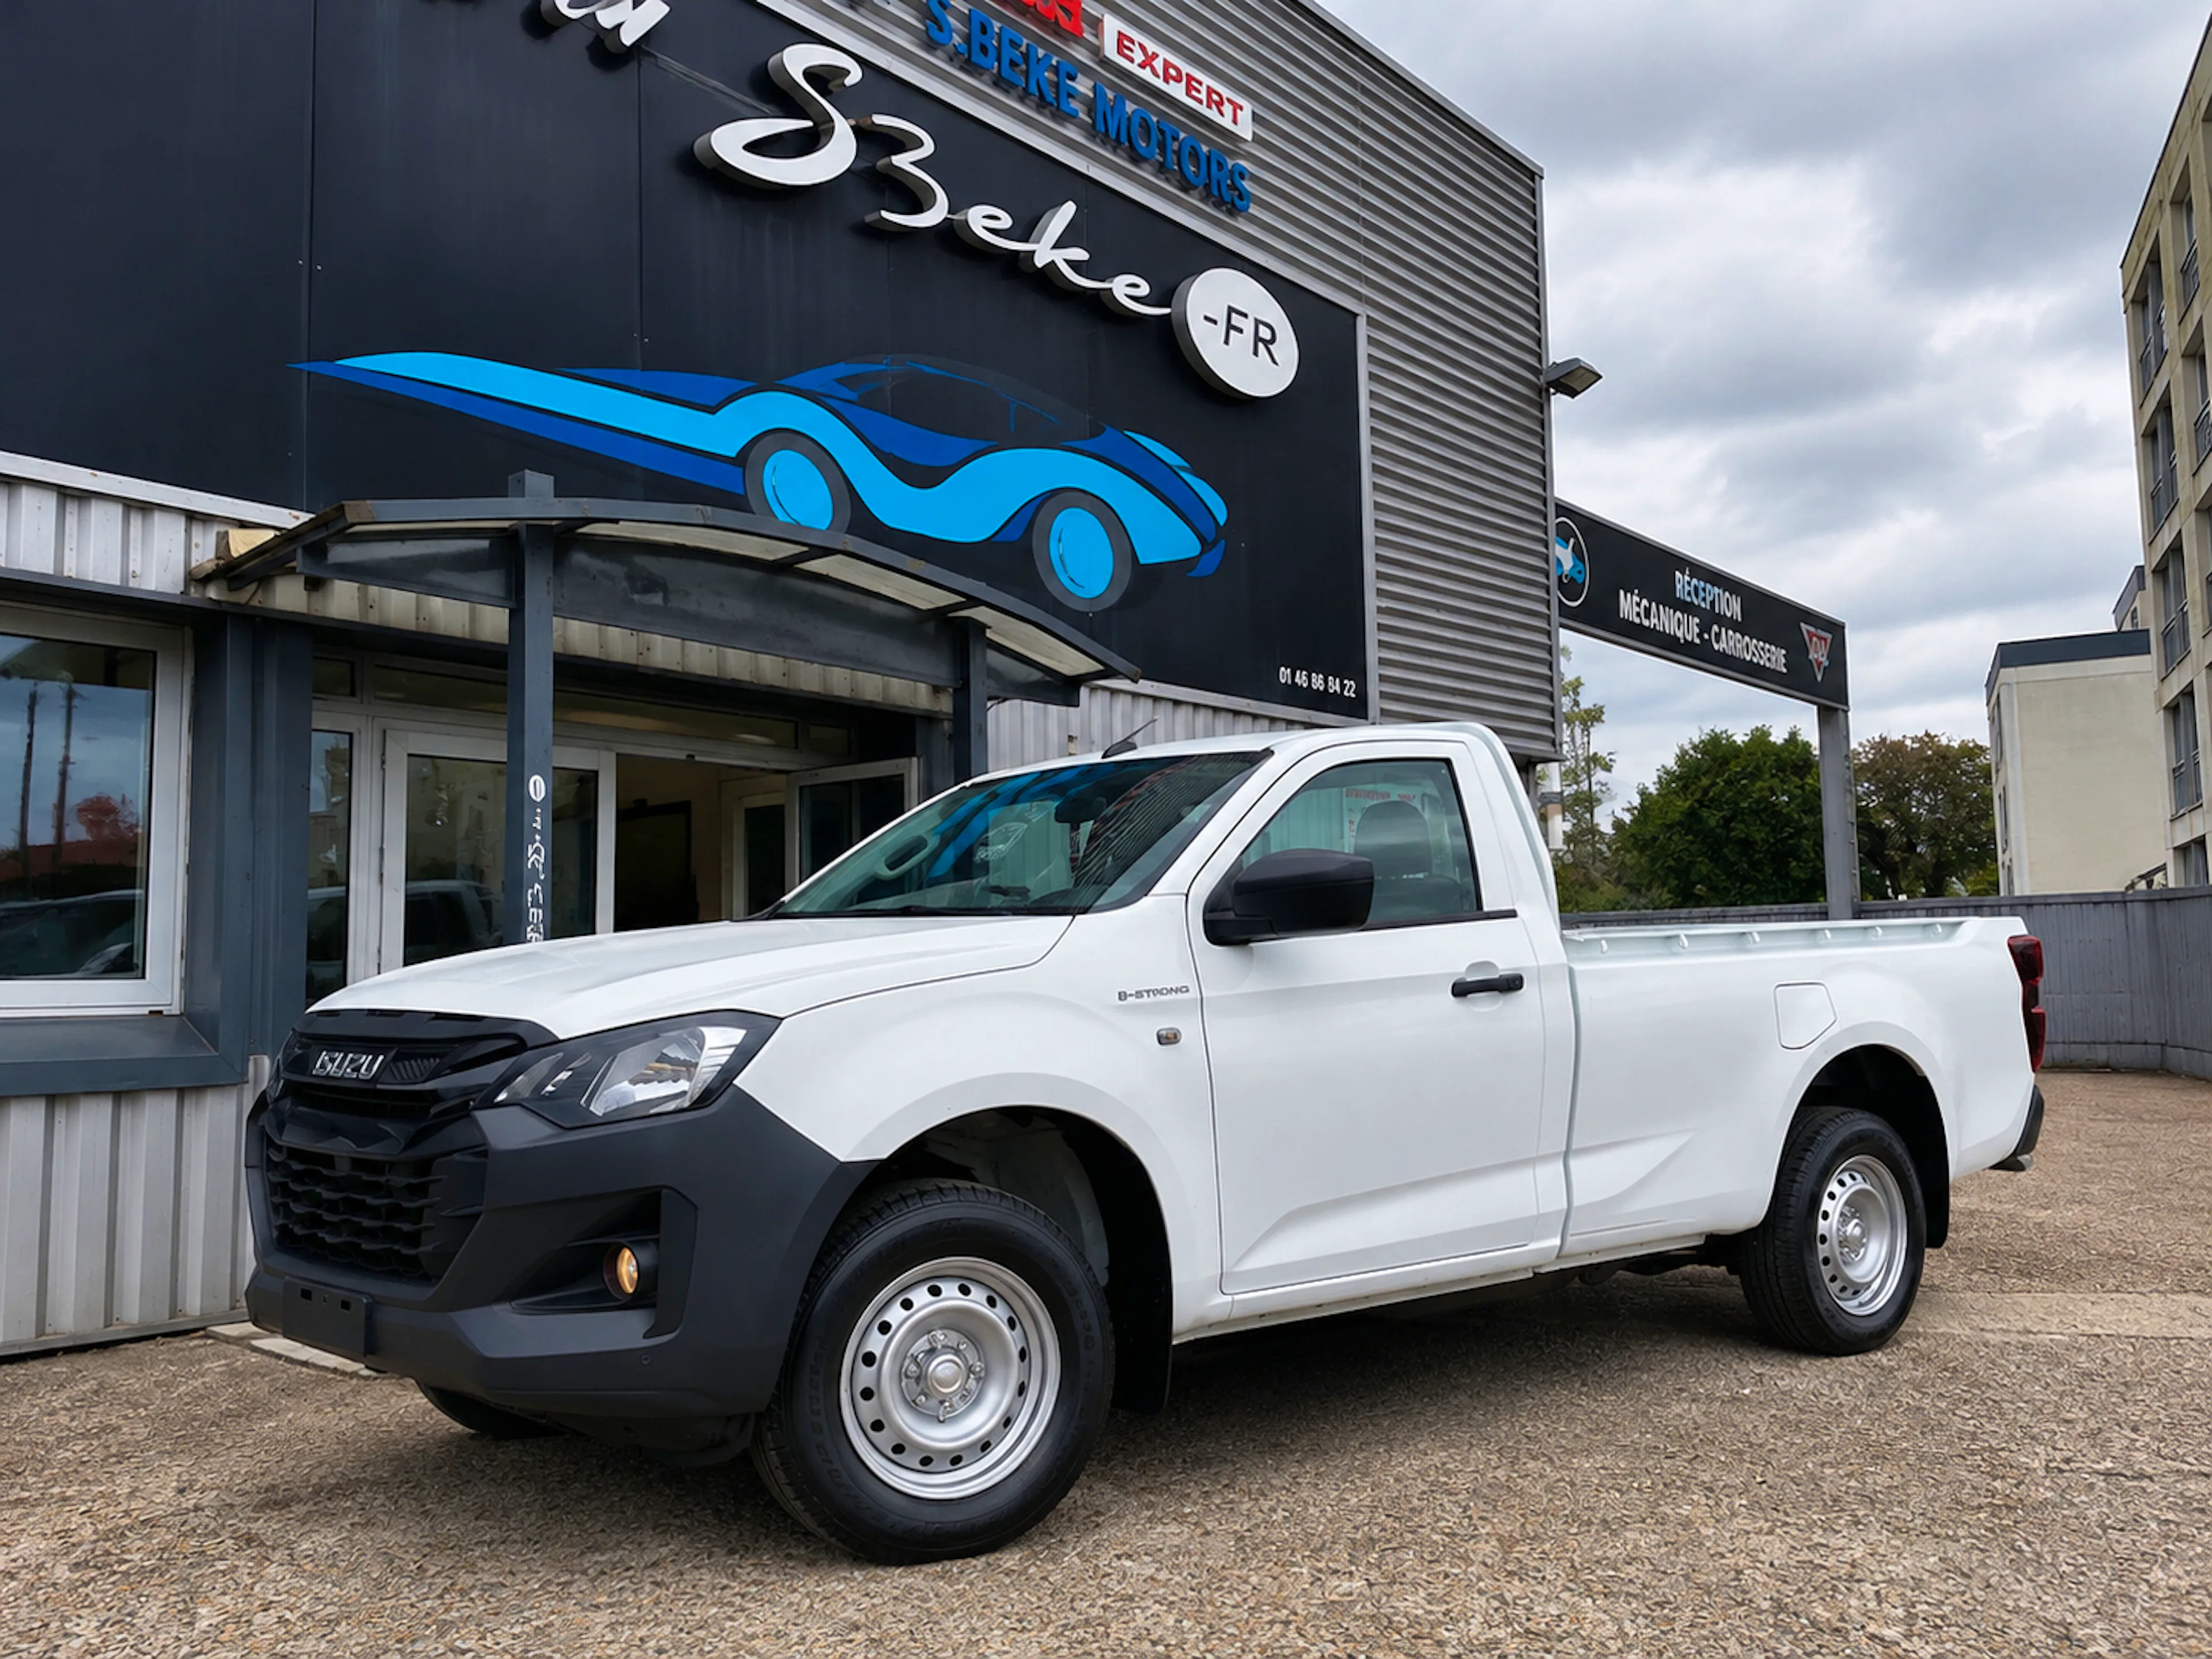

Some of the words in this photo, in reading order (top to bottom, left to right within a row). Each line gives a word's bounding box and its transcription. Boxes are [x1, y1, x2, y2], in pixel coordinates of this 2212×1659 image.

[926, 0, 1080, 118] S.BEKE
[1093, 82, 1252, 213] MOTORS
[1116, 29, 1244, 126] EXPERT
[1675, 567, 1742, 623] RÉCEPTION
[1619, 589, 1700, 644] MÉCANIQUE
[1711, 624, 1787, 673] CARROSSERIE
[1279, 666, 1291, 685] 01
[1343, 679, 1356, 698] 22
[312, 1050, 385, 1080] ISUZU
